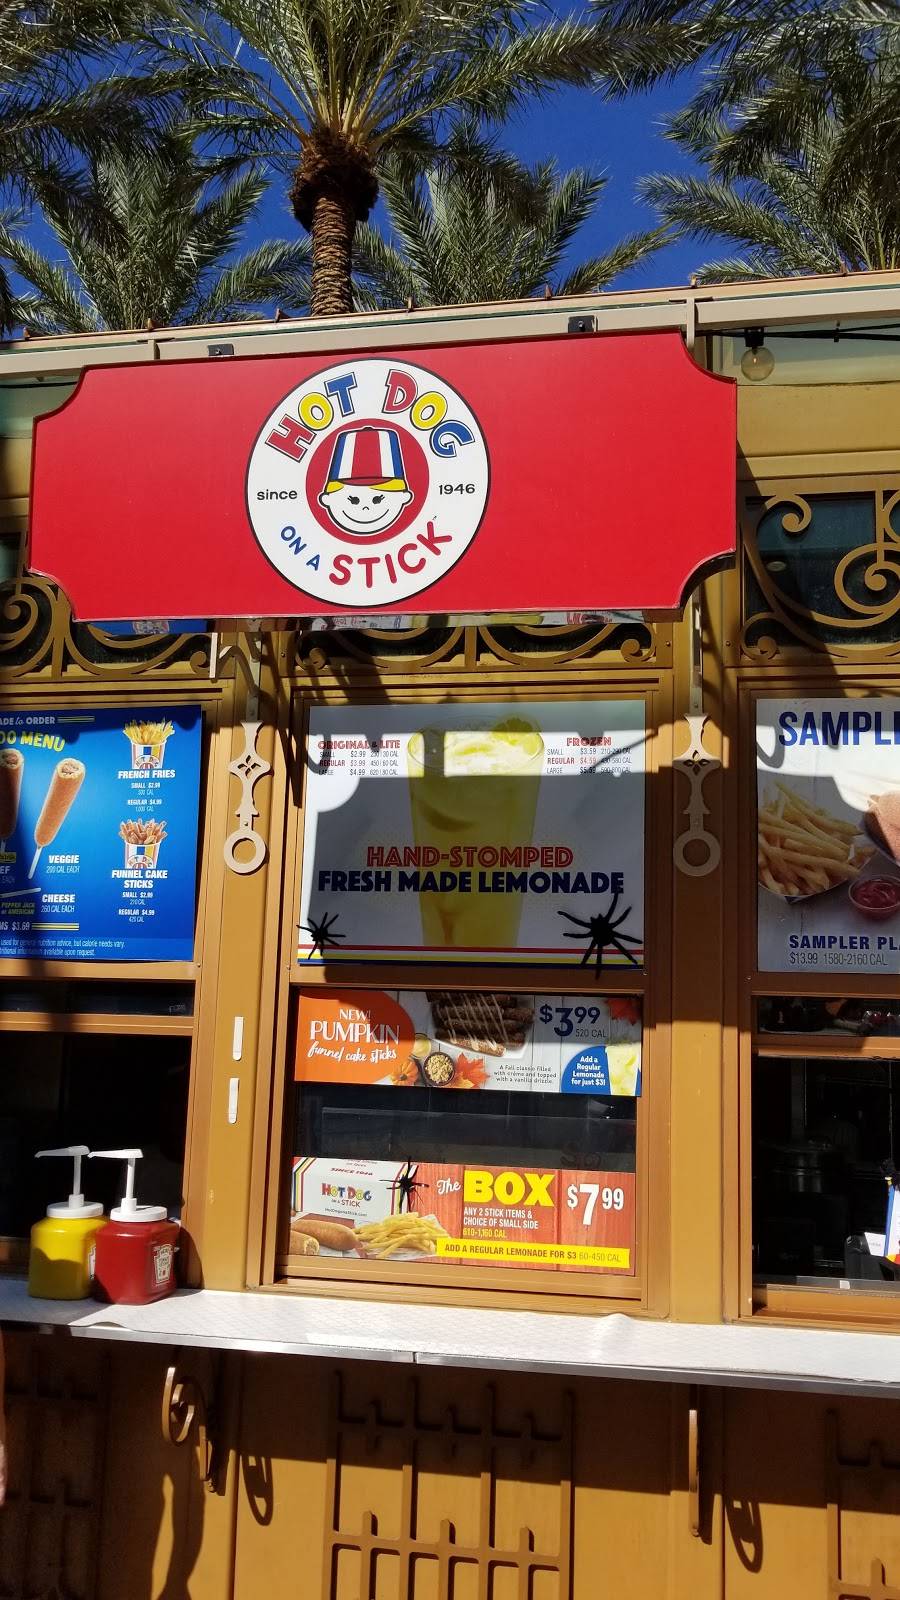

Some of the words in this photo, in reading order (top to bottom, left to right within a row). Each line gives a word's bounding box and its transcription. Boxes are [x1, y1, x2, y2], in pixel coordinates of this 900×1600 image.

[265, 372, 358, 463] HOT
[382, 369, 475, 458] DOG
[257, 488, 298, 501] since
[438, 483, 476, 495] 1946
[281, 526, 307, 555] ON
[306, 554, 321, 571] A
[329, 521, 453, 588] STICK
[26, 717, 55, 725] ORDER
[20, 731, 65, 752] MENU
[318, 740, 370, 750] ORIGINAL
[380, 740, 400, 749] LITE
[567, 737, 612, 746] FROZEN
[118, 770, 149, 779] FRENCH
[152, 769, 176, 778] FRIES
[48, 855, 80, 864] VEGGIE
[367, 846, 574, 868] HAND-STOMPED
[111, 870, 143, 879] FUNNEL
[145, 870, 168, 879] CAKE
[124, 880, 154, 889] STICKS
[318, 871, 392, 892] FRESH
[398, 871, 472, 893] MADE
[478, 871, 624, 894] LEMONADE
[42, 894, 76, 903] CHEESE
[789, 934, 870, 950] SAMPLER
[877, 936, 900, 951] PL
[789, 951, 818, 965] $13.99
[823, 952, 868, 965] 1580-2160
[869, 953, 888, 966] CAL
[339, 1008, 371, 1021] NEW!
[310, 1020, 400, 1045] PUMPKIN
[575, 1028, 589, 1038] 520
[591, 1029, 607, 1038] CAL
[307, 1041, 344, 1062] funnel
[345, 1048, 367, 1062] cake
[370, 1045, 397, 1064] sticks
[576, 1063, 601, 1072] Regular
[572, 1071, 605, 1079] Lemonade
[571, 1078, 581, 1086] for
[581, 1078, 595, 1087] just
[322, 1183, 346, 1198] HOT
[347, 1186, 372, 1201] DOG
[436, 1178, 461, 1195] The
[464, 1170, 555, 1207] BOX
[341, 1200, 361, 1208] STICK
[464, 1207, 477, 1216] ANY
[479, 1208, 484, 1216] 2
[484, 1208, 504, 1217] STICK
[505, 1209, 525, 1218] ITEMS
[527, 1210, 533, 1219] &
[463, 1217, 487, 1226] CHOICE
[488, 1218, 498, 1227] OF
[499, 1219, 521, 1228] SMALL
[522, 1220, 539, 1229] SIDE
[494, 1229, 507, 1238] CAL
[445, 1243, 461, 1252] ADD
[462, 1244, 468, 1252] A
[469, 1244, 504, 1255] REGULAR
[506, 1247, 548, 1258] LEMONADE
[549, 1249, 565, 1258] FOR
[567, 1251, 577, 1260] $3
[607, 1253, 621, 1262] CAL
